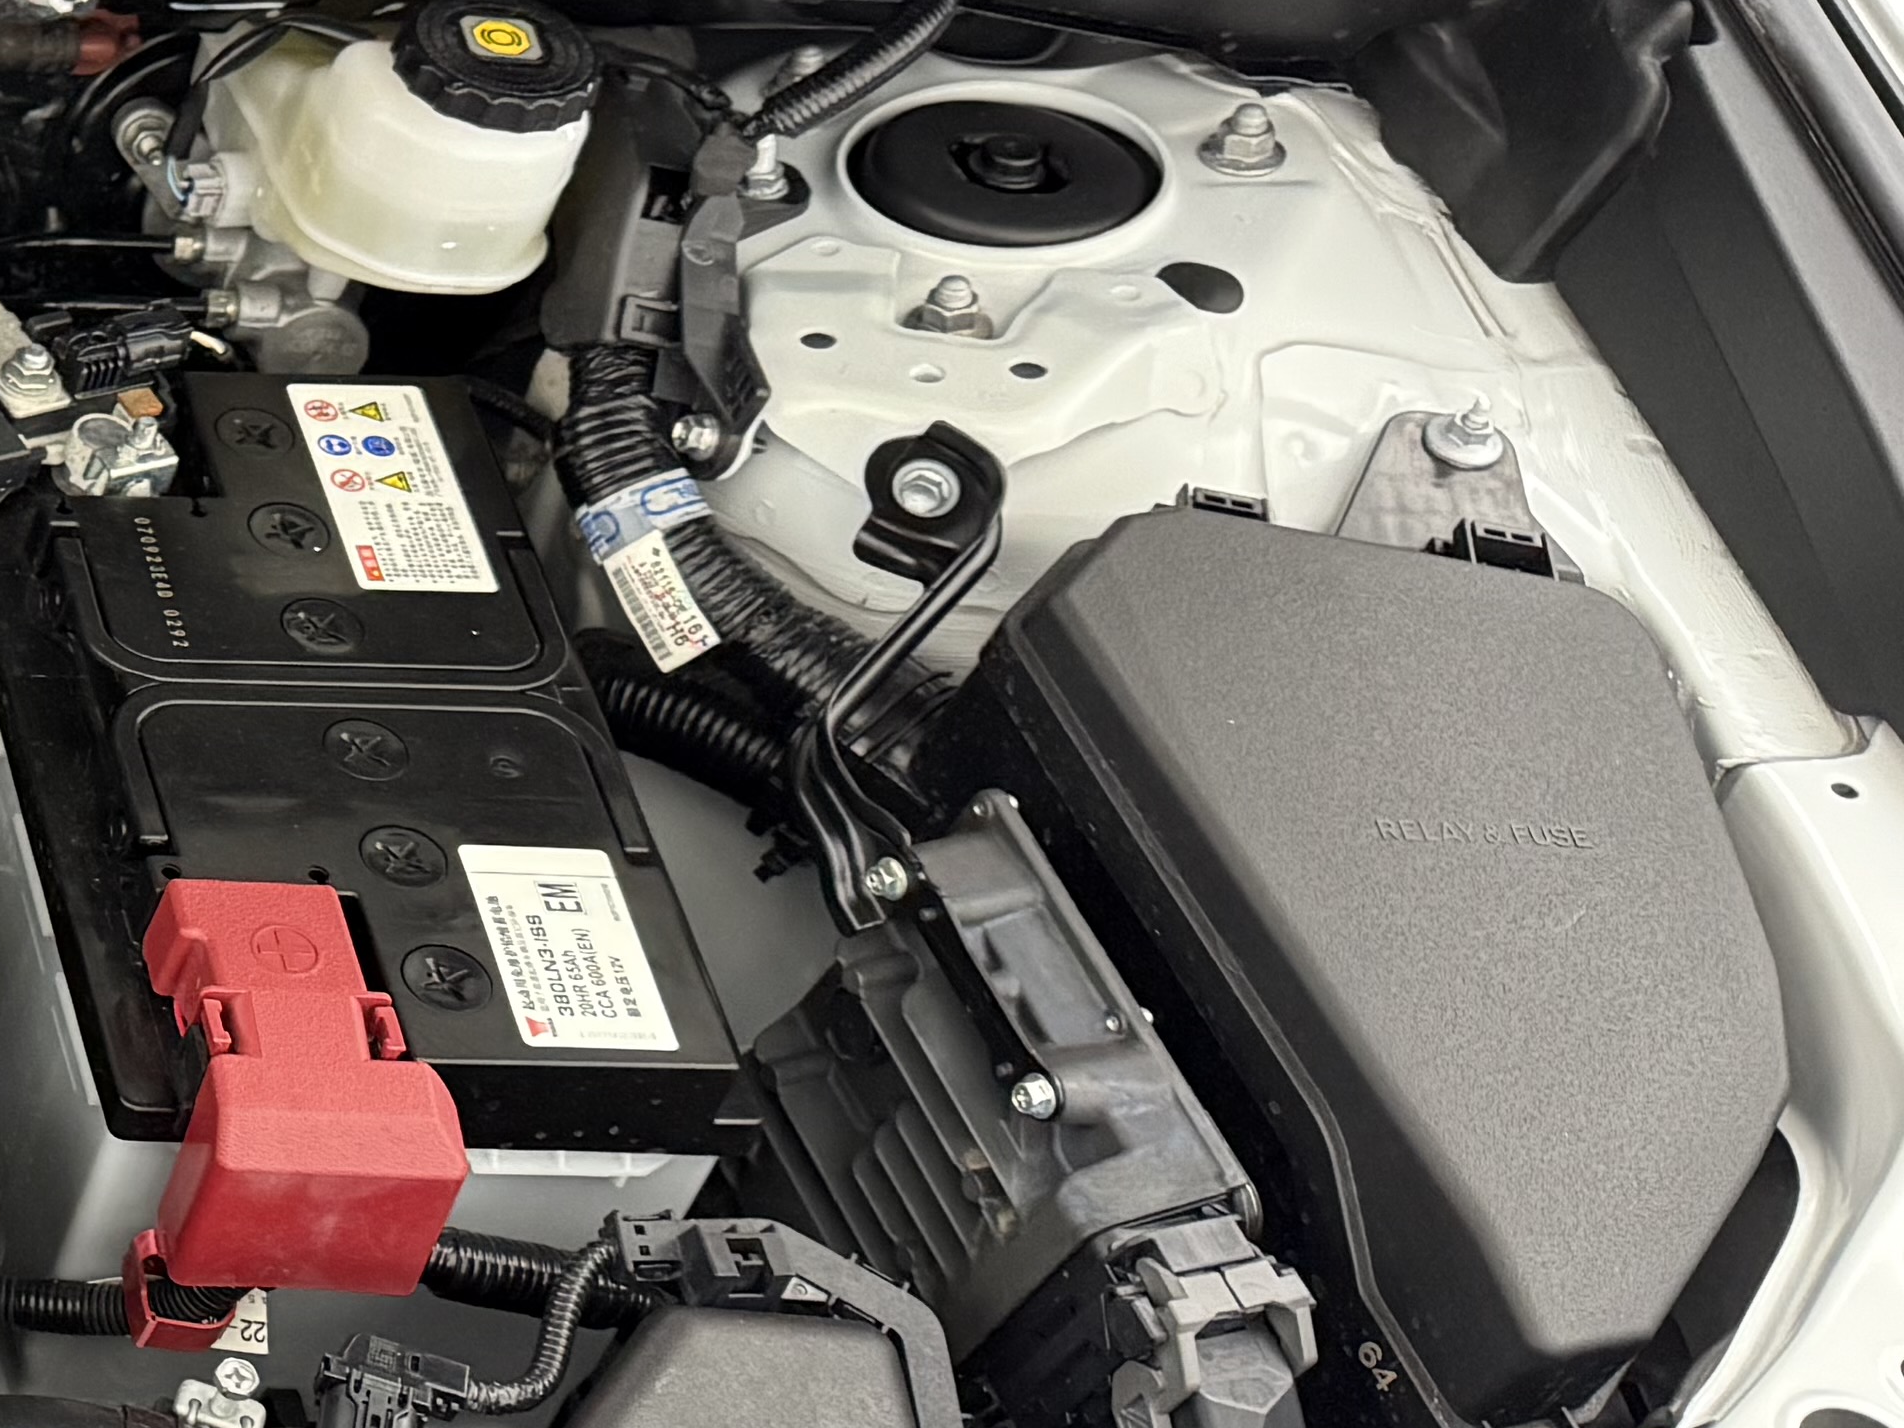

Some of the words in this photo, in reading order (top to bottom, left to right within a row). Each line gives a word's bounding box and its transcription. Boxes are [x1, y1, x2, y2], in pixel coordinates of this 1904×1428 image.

[1375, 818, 1474, 843] RELAY
[1483, 824, 1501, 844] &
[1509, 822, 1594, 849] FUSE
[537, 883, 583, 912] EM
[559, 949, 584, 980] 65Ah
[570, 928, 608, 986] 600A(EN)
[571, 985, 597, 1016] 20HR
[595, 990, 618, 1018] CCA
[1358, 1341, 1398, 1392] 64
